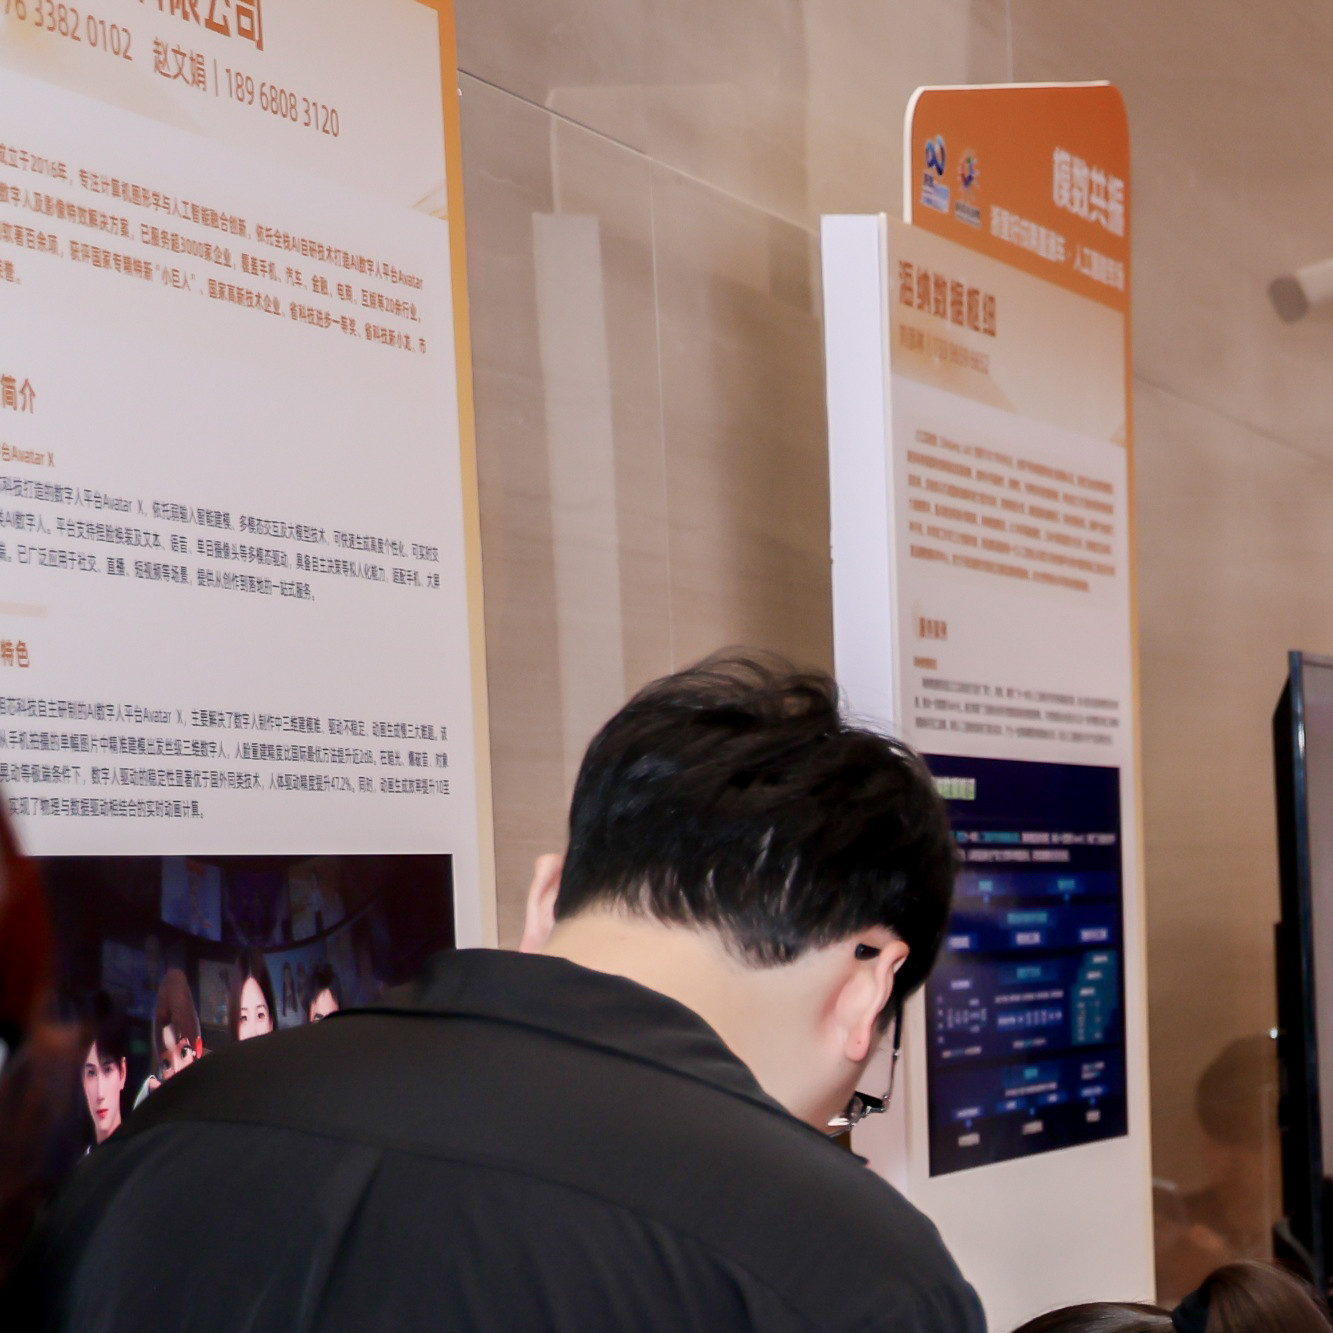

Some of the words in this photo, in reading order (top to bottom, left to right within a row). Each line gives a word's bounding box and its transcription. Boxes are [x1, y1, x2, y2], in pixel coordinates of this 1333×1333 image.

[34, 0, 81, 42] 3382
[87, 14, 133, 61] 0102
[225, 68, 255, 106] 189
[260, 81, 298, 123] 6808
[302, 97, 339, 138] 3120
